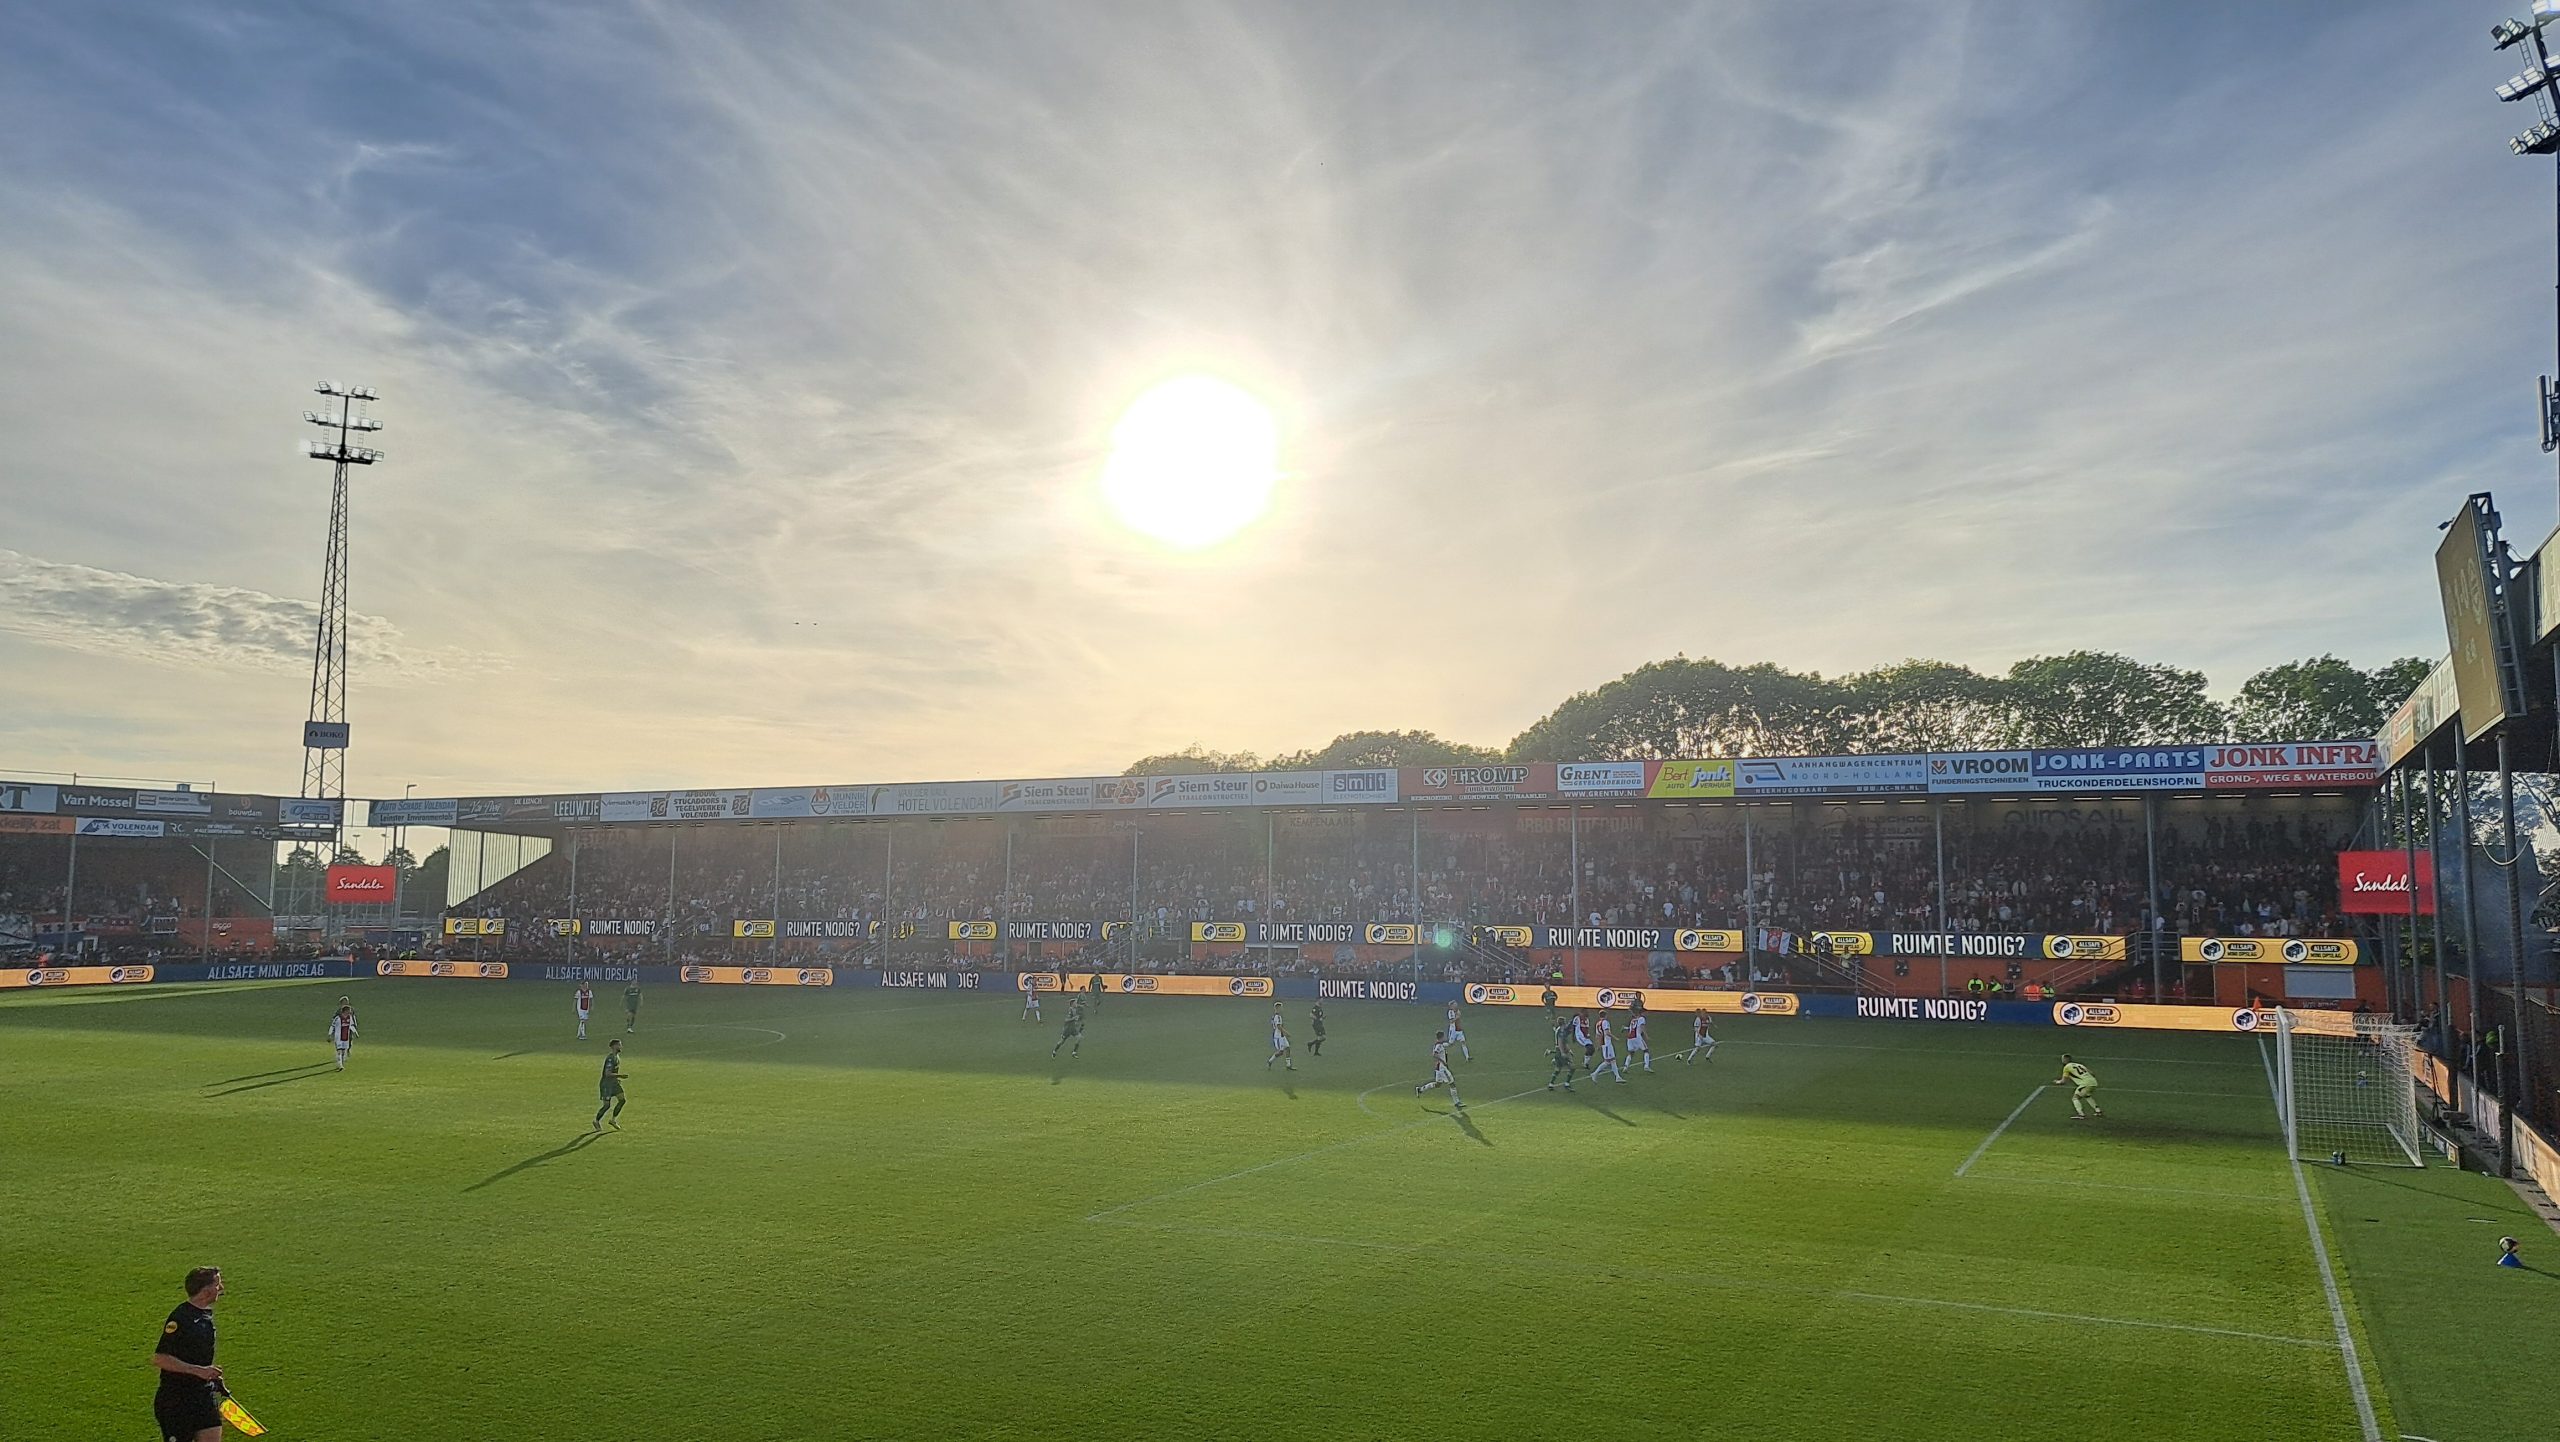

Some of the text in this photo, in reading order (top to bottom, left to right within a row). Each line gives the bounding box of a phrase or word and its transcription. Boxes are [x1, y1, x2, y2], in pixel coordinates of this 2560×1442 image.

[2036, 750, 2200, 770] JONK-PARTS
[2210, 744, 2377, 768] JONK INFRA
[1792, 760, 1922, 768] AANHANGWAGENCENTRUM
[1952, 758, 2029, 774] VROOM
[1451, 766, 1528, 785] TROMP
[1560, 766, 1611, 780] GRENT
[1663, 767, 1688, 782] Bert
[1792, 770, 1923, 780] NOORD-HOLLAND
[1932, 776, 2029, 785] FUNDERINGSTECHNIEKEN
[2210, 774, 2260, 784] GROND-,
[2263, 774, 2290, 782] WEG
[2293, 774, 2304, 782] &
[1179, 780, 1248, 792] Siem Steur
[1334, 773, 1386, 792] smit
[2037, 776, 2201, 788] TRUCKONDERDELENSHOP.NL
[1024, 784, 1090, 798] Siem Steur
[62, 794, 133, 808] Van Mossel
[554, 800, 600, 817] LEEUWTJE
[898, 797, 993, 812] HOTEL VOLENDAM
[228, 808, 263, 818] bouwdam
[41, 820, 62, 831] zat
[112, 823, 159, 831] VOLENDAM
[336, 878, 384, 890] Sandals
[589, 920, 656, 936] RUIMTE NODIG?
[786, 922, 822, 936] RUIMTE
[824, 922, 860, 937] NODIG?
[1009, 922, 1092, 940] RUIMTE NODIG?
[1308, 924, 1354, 942] NODIG?
[1606, 930, 1660, 948] NODIG?
[1892, 934, 2026, 956] RUIMTE NODIG?
[208, 964, 324, 980] ALLSAFE MINI OPSLAG
[546, 967, 581, 980] ALLSAFE
[605, 968, 638, 980] OPSLAG
[882, 971, 924, 988] ALLSAFE
[1319, 980, 1416, 1000] RUIMTE NODIG?
[1857, 997, 1988, 1020] RUIMTE NODIG?
